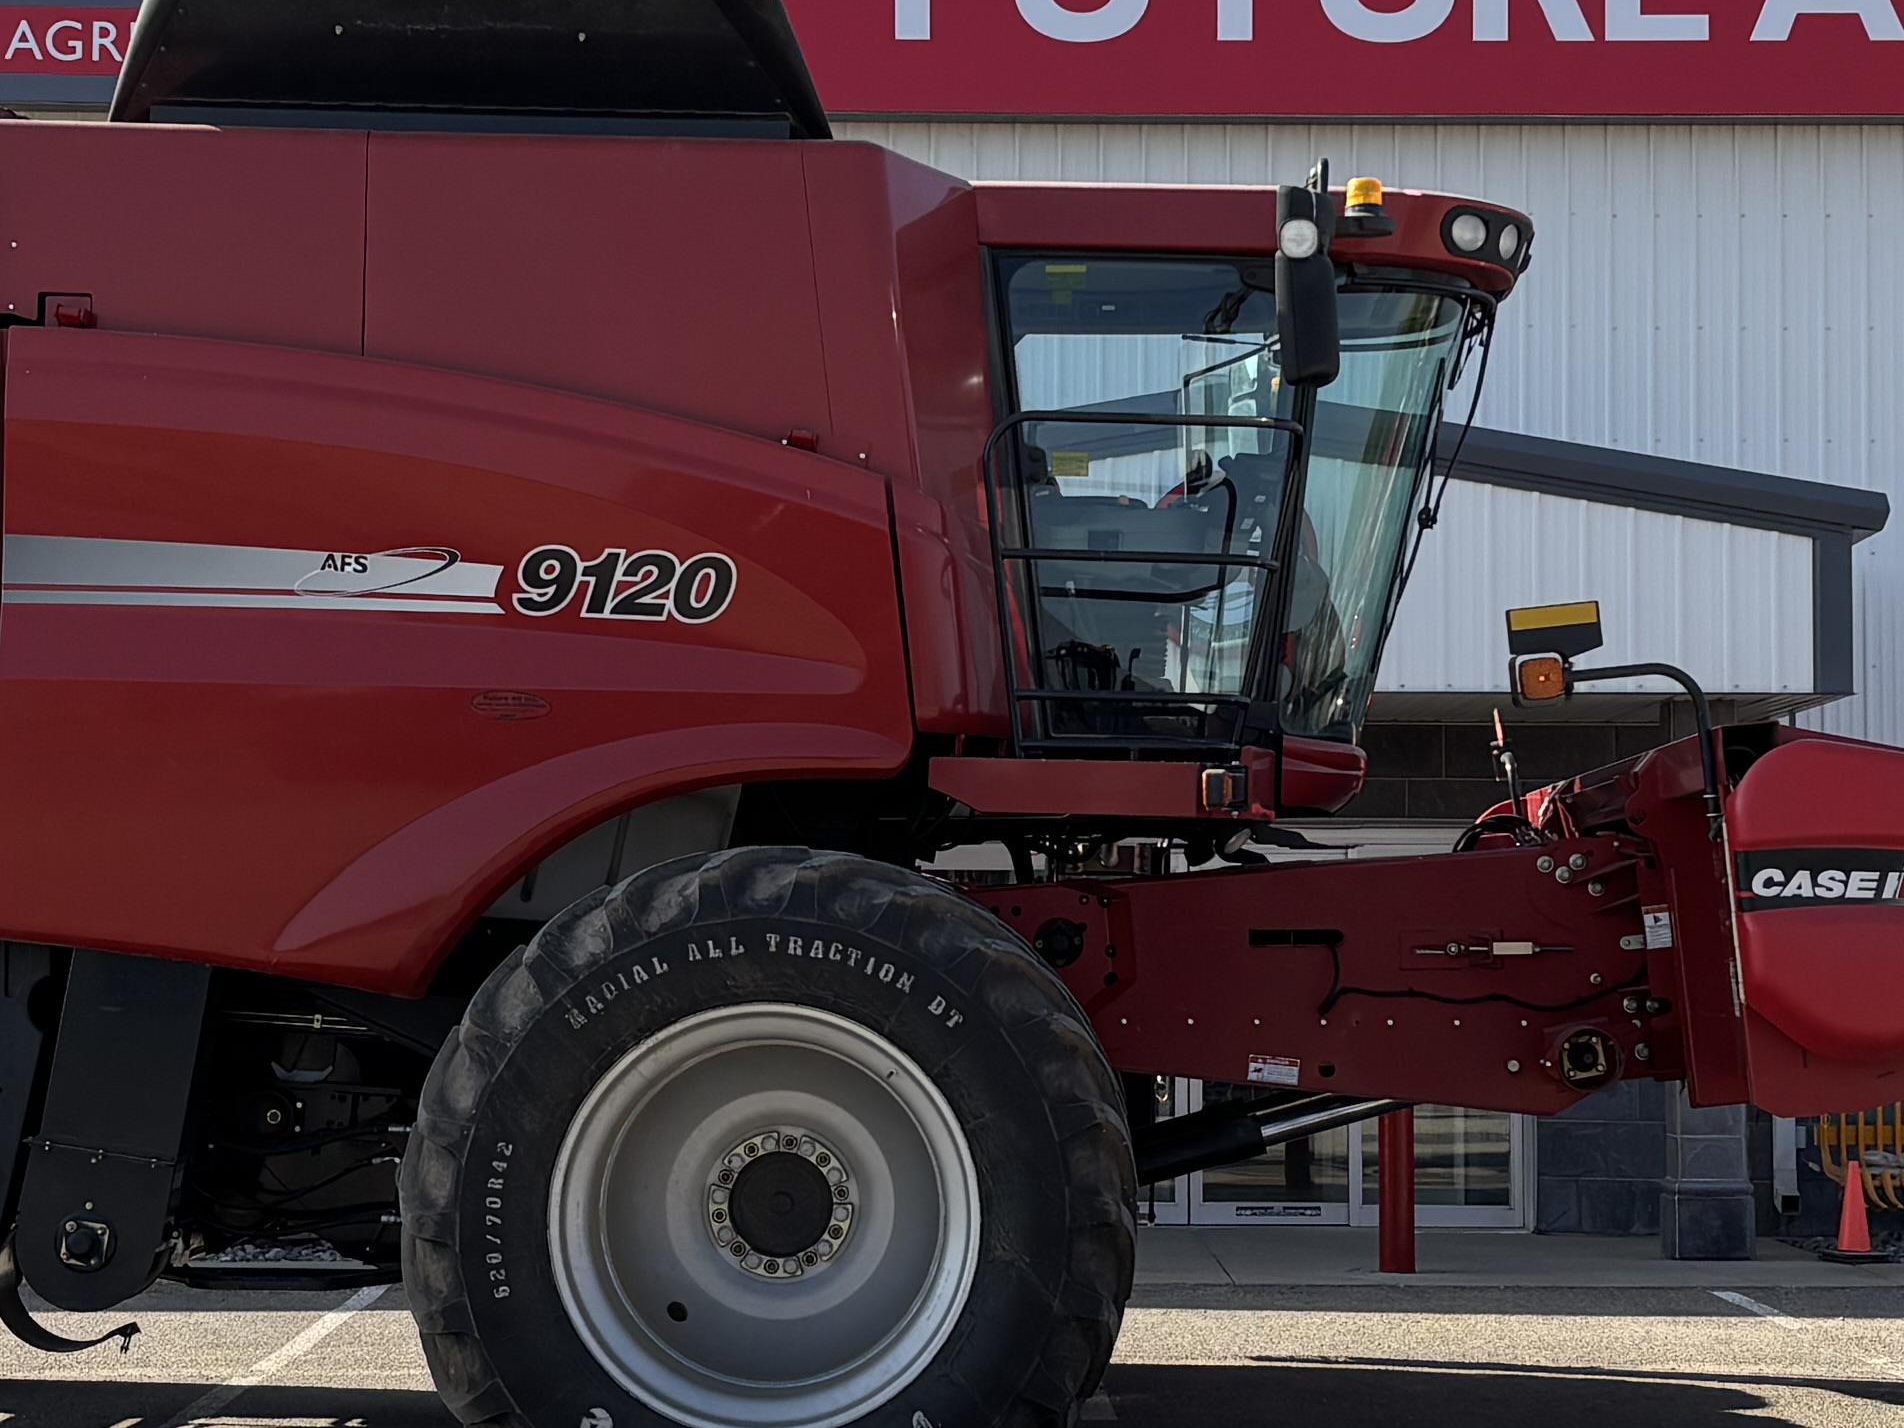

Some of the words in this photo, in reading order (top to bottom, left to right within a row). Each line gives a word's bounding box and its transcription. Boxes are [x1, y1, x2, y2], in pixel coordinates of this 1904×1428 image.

[319, 553, 369, 575] AFS
[512, 545, 737, 624] 9120
[1752, 868, 1880, 899] CASE
[565, 957, 670, 1030] RADIAL
[688, 937, 746, 962] ALL
[766, 933, 915, 994] TRACTION
[927, 996, 964, 1028] DT
[485, 1141, 513, 1299] 620/70R42
